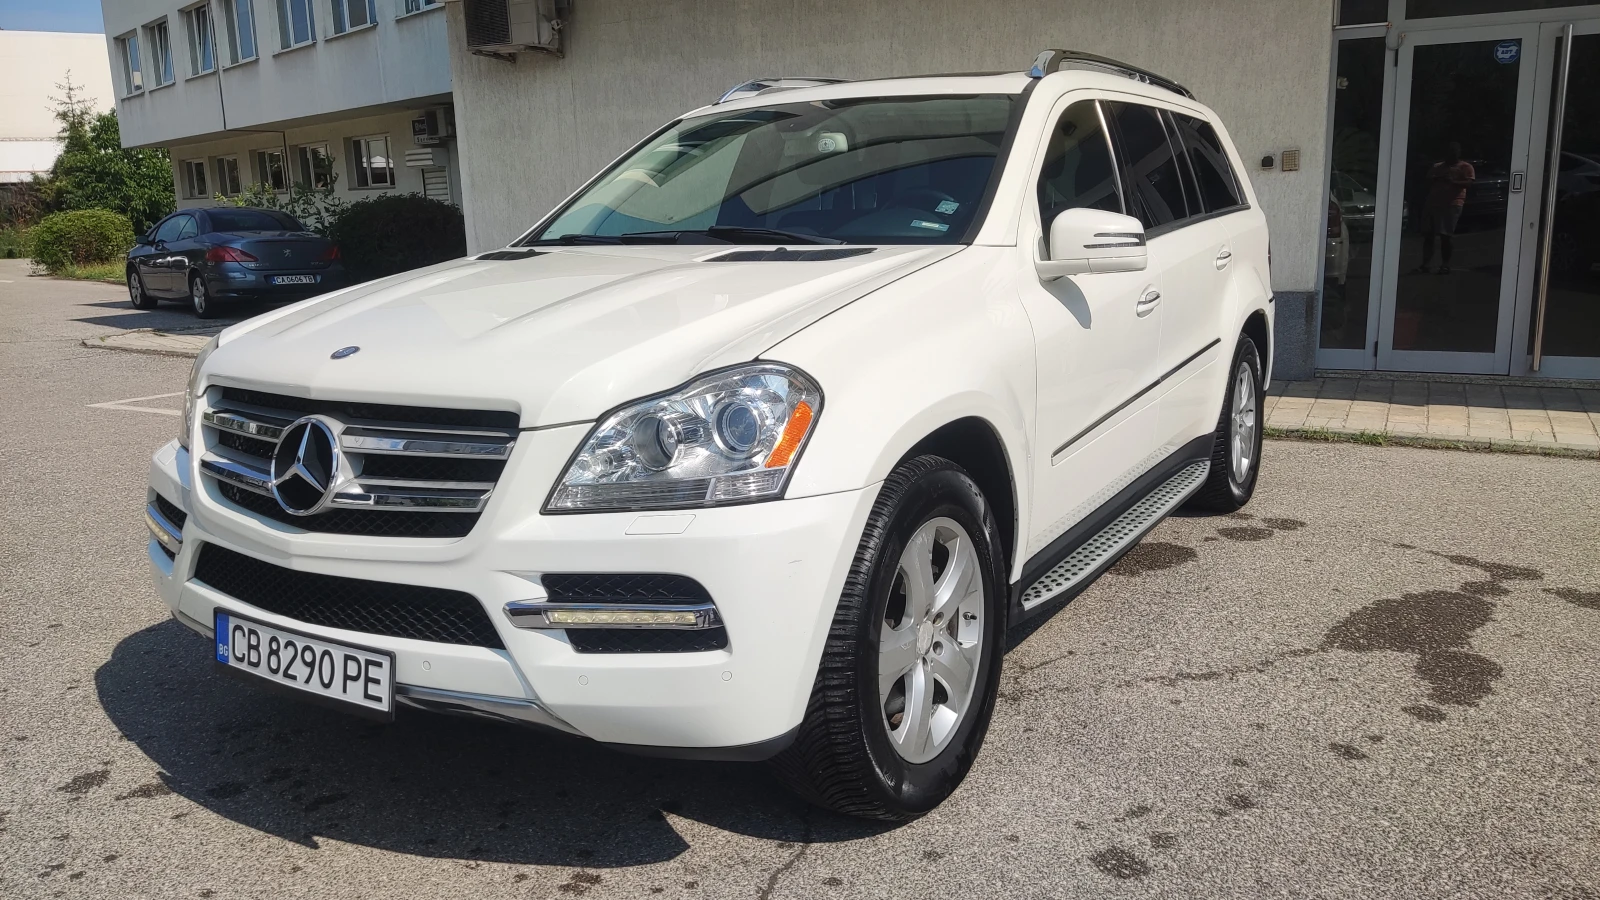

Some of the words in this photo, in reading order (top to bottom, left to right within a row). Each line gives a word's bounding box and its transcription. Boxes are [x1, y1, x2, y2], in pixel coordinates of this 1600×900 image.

[276, 276, 286, 284] CA
[218, 643, 229, 657] BG
[232, 624, 262, 668] CB
[267, 635, 335, 689] 8290
[343, 653, 383, 704] PE
